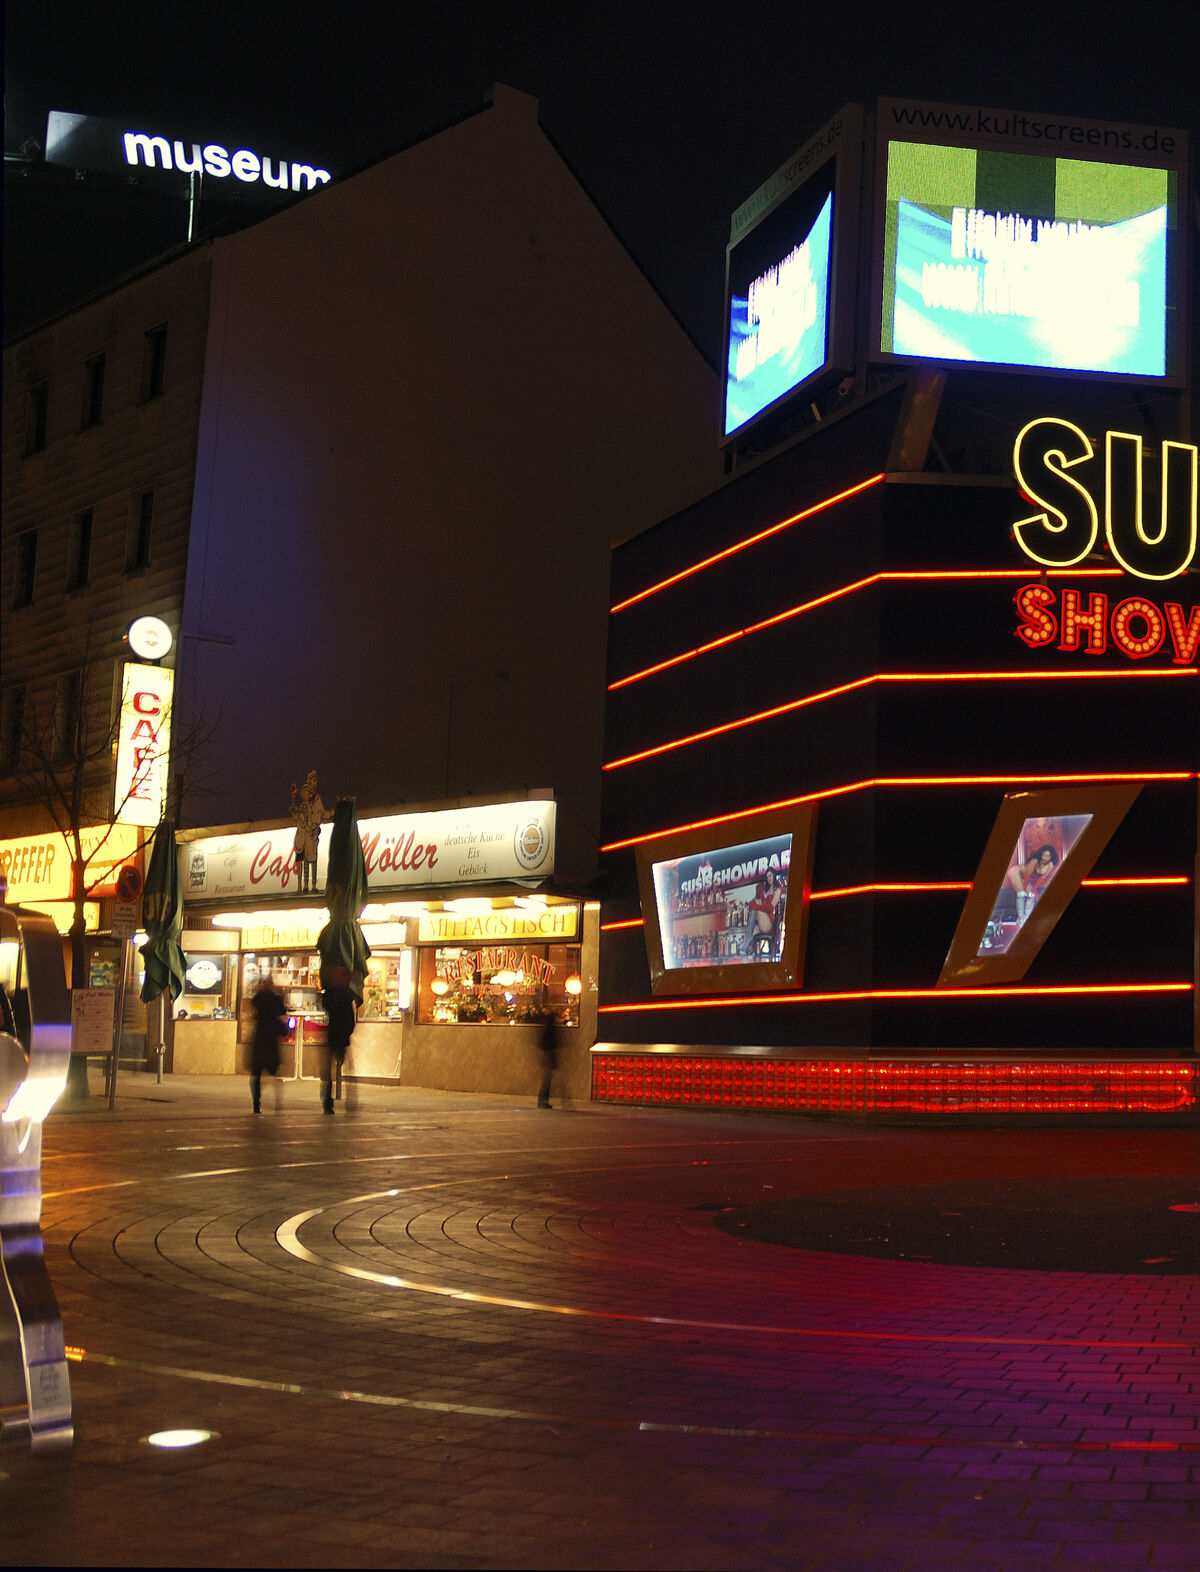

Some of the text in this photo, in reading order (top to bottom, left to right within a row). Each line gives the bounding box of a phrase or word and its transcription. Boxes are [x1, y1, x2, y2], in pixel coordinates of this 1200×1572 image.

[892, 105, 1176, 154] www.kultscreens.de
[123, 130, 331, 192] museum
[360, 830, 439, 875] Möller
[444, 832, 478, 846] deutsche
[467, 847, 481, 859] Eis
[443, 949, 556, 986] RESTAURANT
